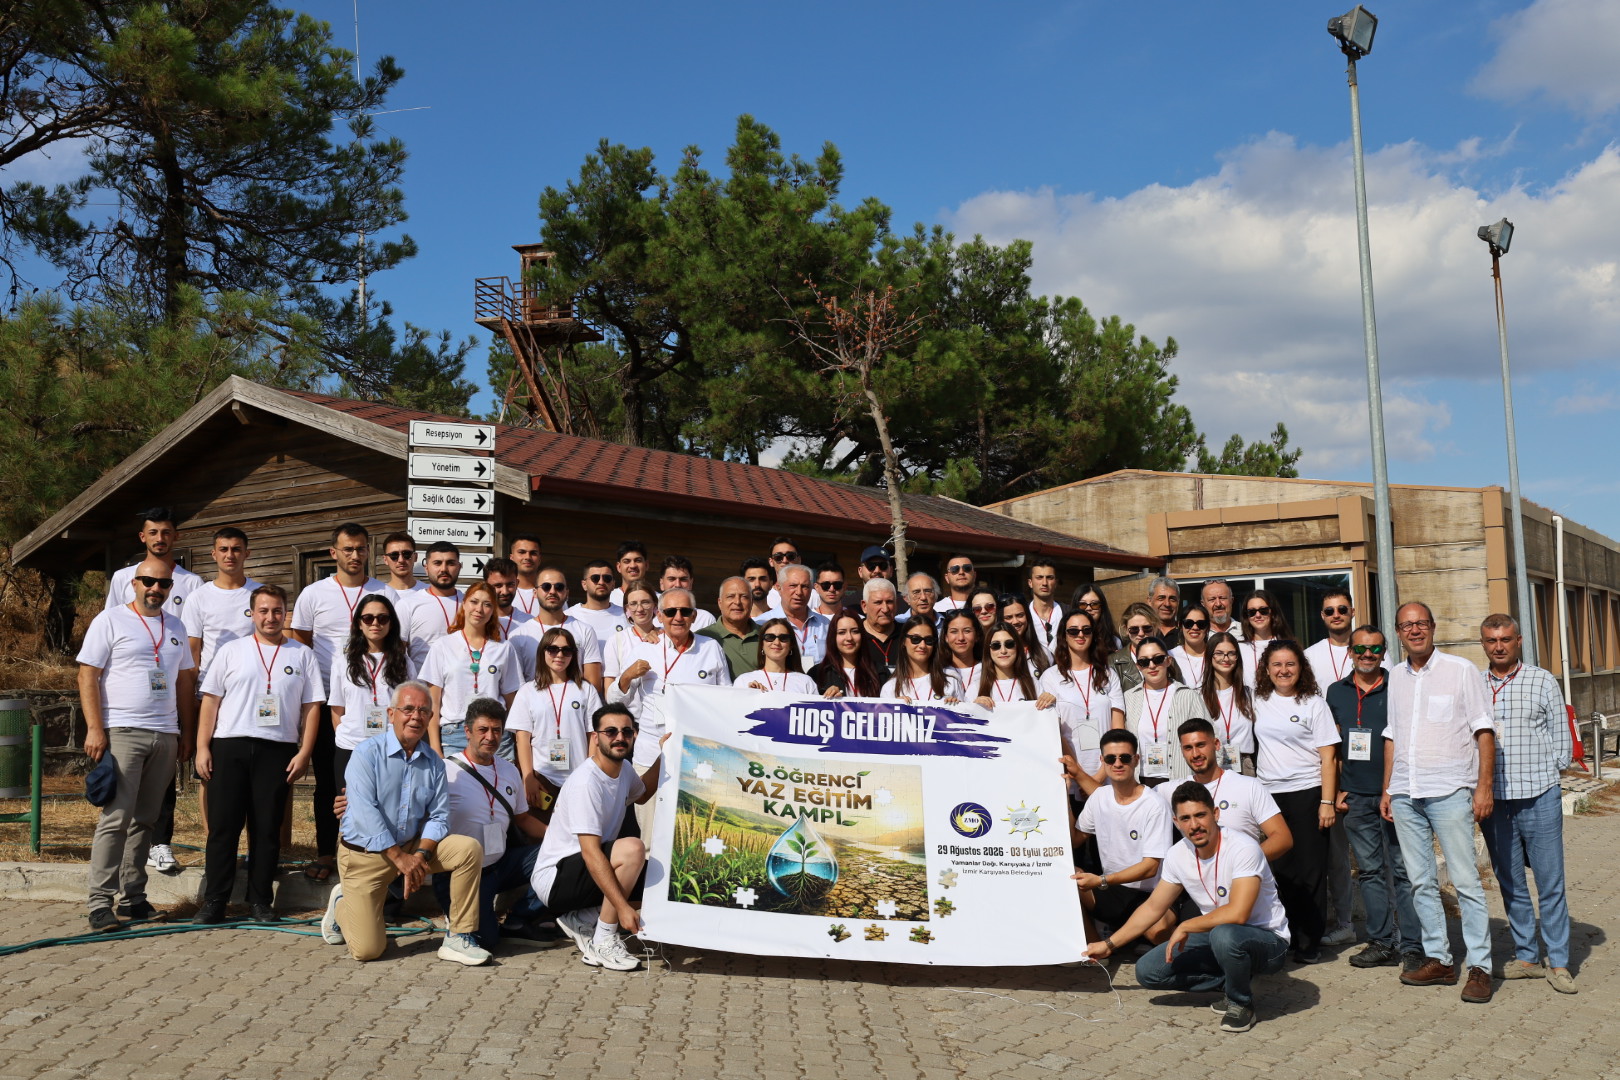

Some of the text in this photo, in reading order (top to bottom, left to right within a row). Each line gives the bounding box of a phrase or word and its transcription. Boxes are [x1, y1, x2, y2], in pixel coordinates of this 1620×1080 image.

[425, 428, 463, 441] Resepsiyon
[431, 462, 461, 473] Yönetim
[422, 493, 465, 505] Sağlık Odası
[418, 526, 469, 537] Seminer Salonu
[788, 706, 937, 744] HOŞ GELDİNİZ
[773, 765, 862, 789] ÖĞRENCİ
[736, 777, 872, 810] YAZ EĞİTİM
[763, 799, 842, 825] KAMPI
[937, 844, 948, 855] 29
[949, 845, 982, 857] Ağustos
[983, 846, 1004, 857] 2026
[1010, 846, 1020, 857] 03
[1023, 847, 1041, 858] Eylül
[1043, 846, 1064, 857] 2026
